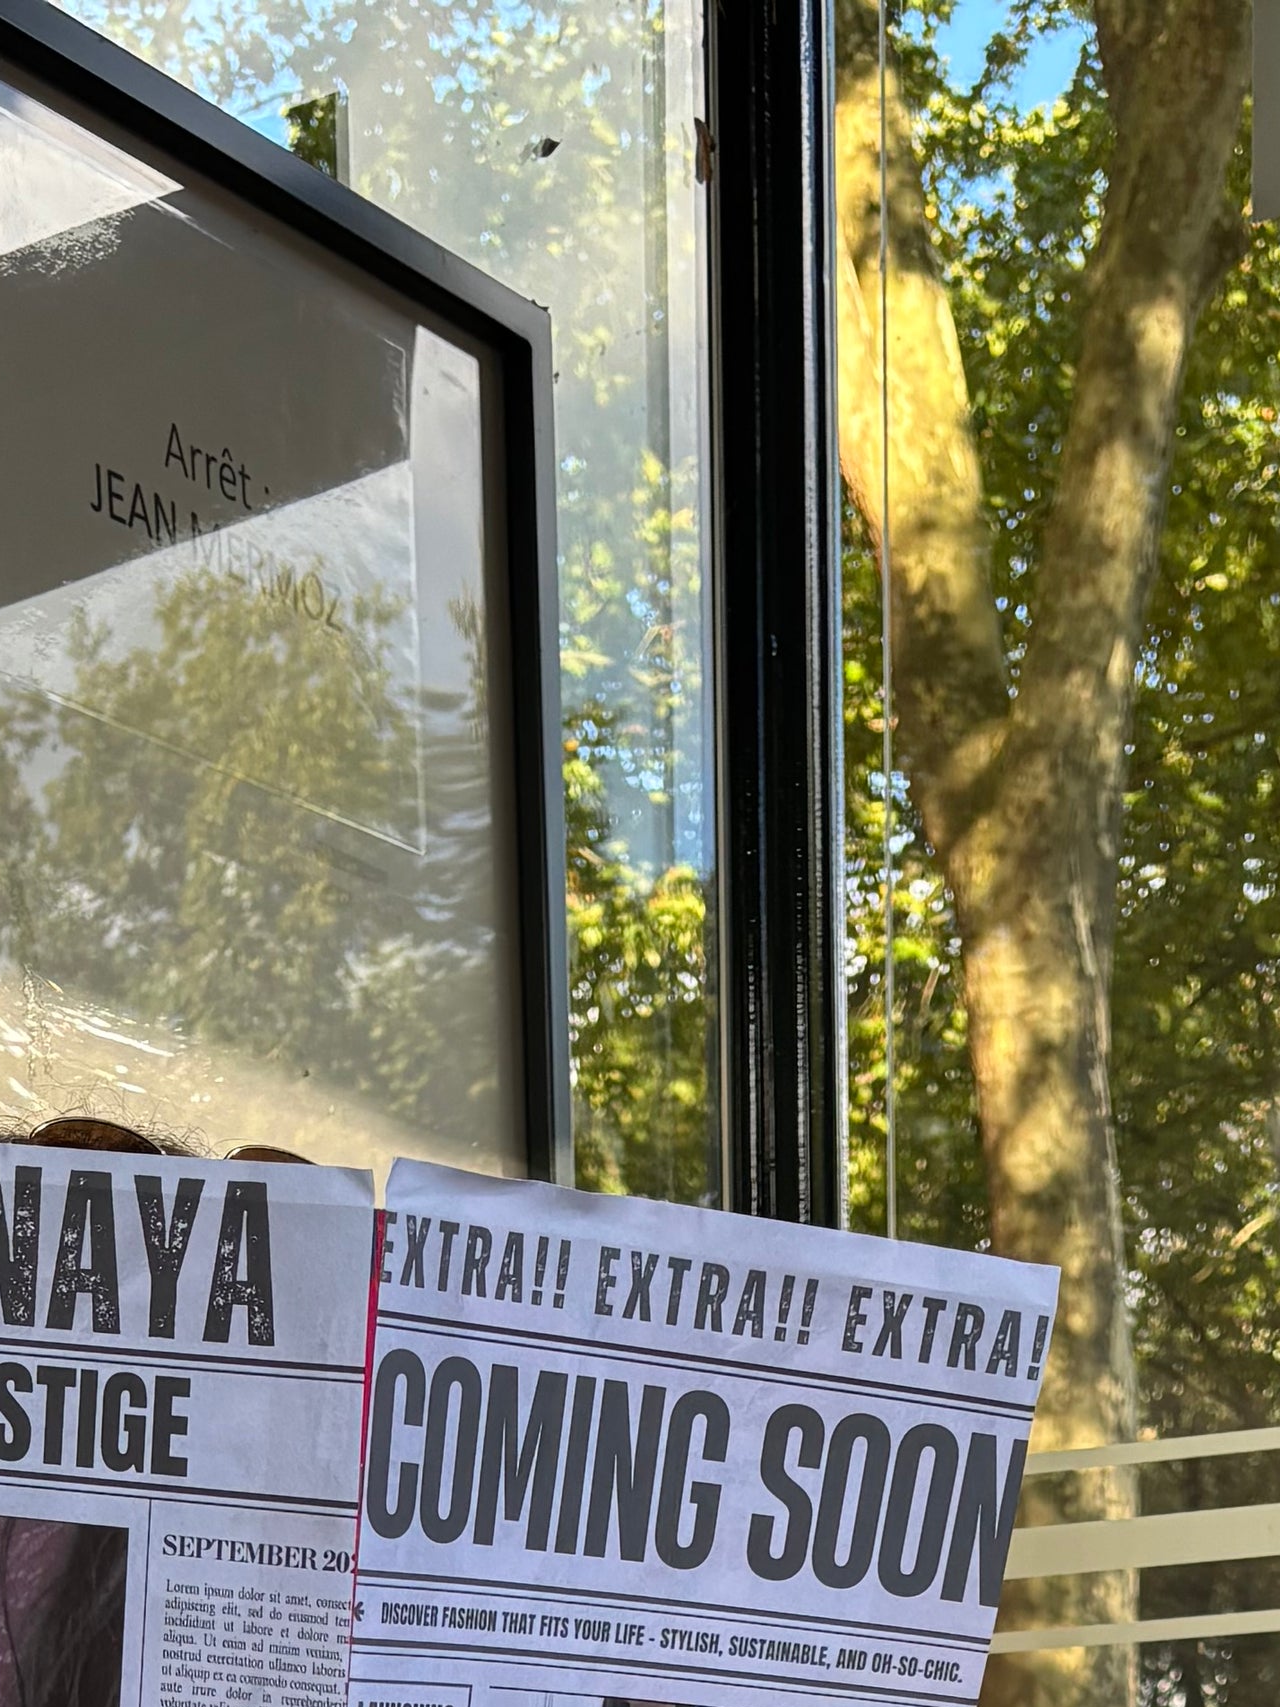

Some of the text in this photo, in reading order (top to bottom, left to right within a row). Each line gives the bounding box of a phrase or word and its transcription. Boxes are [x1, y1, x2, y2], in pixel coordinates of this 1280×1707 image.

[89, 463, 177, 546] JEAN
[165, 422, 252, 510] Arrêt
[380, 1210, 1050, 1382] EXTRA!! EXTRA!! EXTRA!
[366, 1347, 1028, 1609] COMING SOON
[162, 1534, 318, 1571] SEPTEMBER
[166, 1579, 281, 1604] Lorem ipsum dolor sit
[381, 1601, 964, 1684] DISCOVER FASHION THAT FITS YOUR LIFE STYLISH, SUSTAINABLE, AND OH-SO-CHIC.
